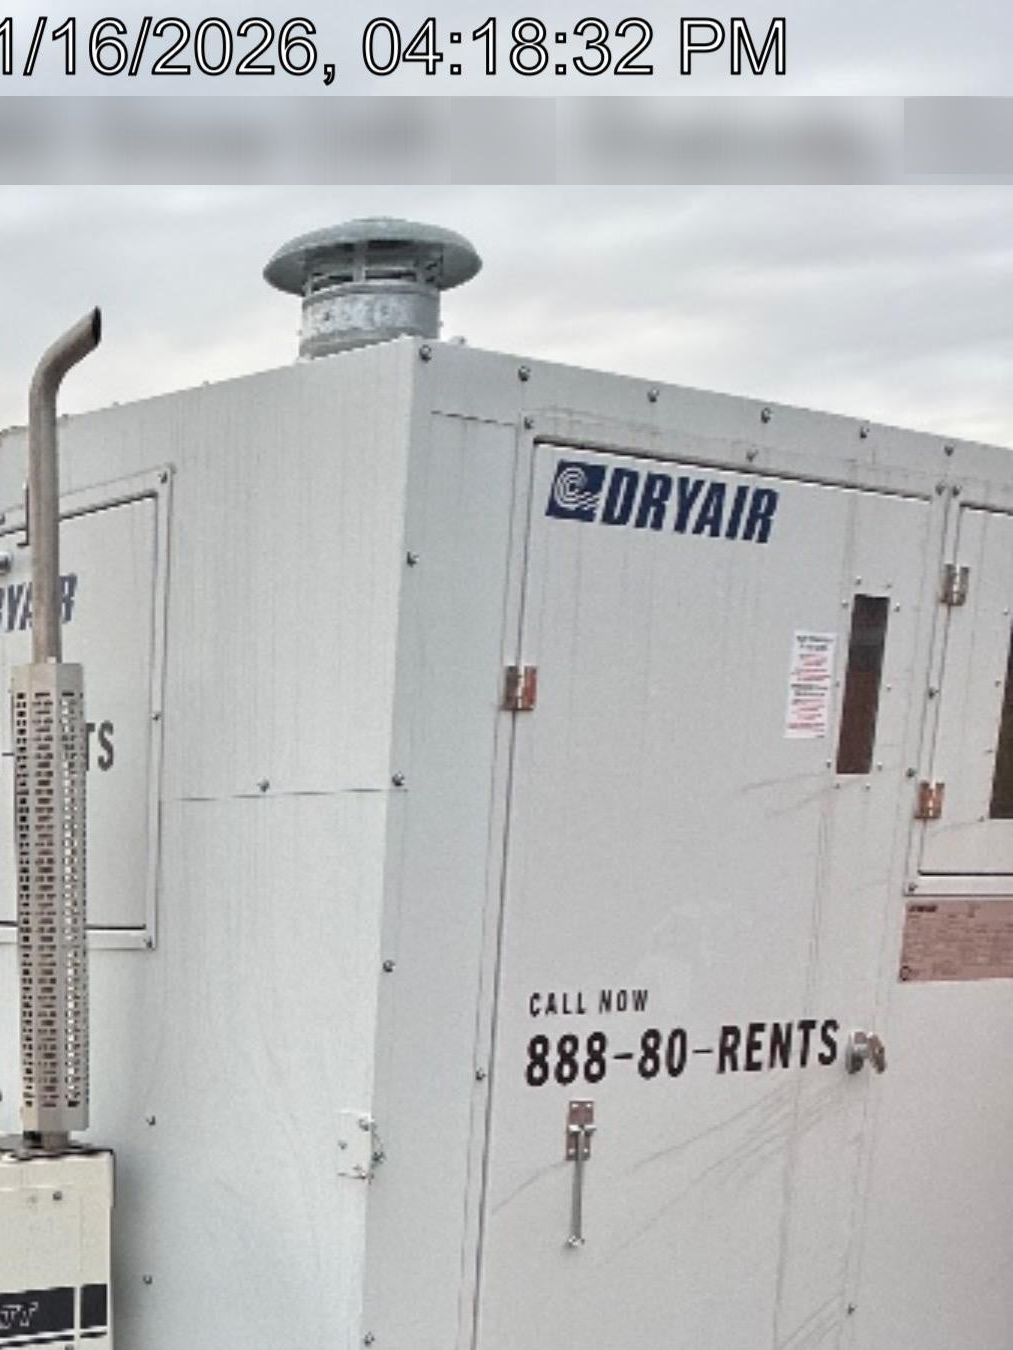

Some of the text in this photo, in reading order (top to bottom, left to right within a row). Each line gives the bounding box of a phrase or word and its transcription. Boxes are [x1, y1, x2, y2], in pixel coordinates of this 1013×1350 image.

[600, 467, 780, 544] DRYAIR
[529, 989, 649, 1017] CALL NOW
[526, 1018, 839, 1087] 888-80-RENTS
